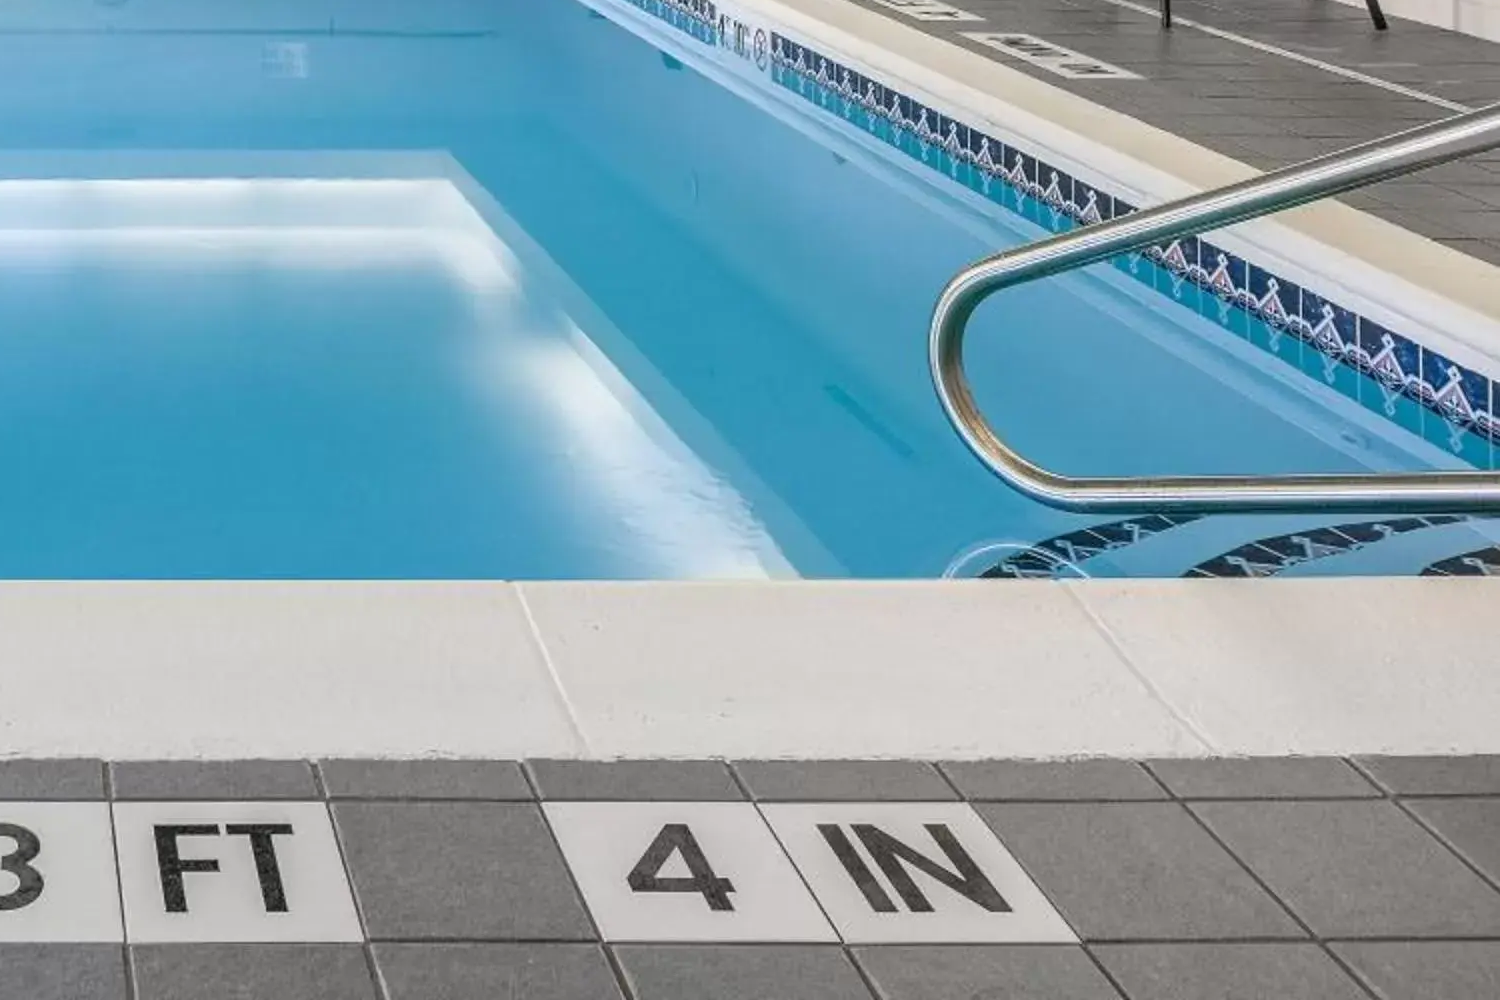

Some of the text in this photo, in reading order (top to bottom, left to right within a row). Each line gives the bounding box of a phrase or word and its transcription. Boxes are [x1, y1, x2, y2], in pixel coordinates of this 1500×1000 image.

[153, 823, 294, 913] FT
[627, 823, 736, 912] 4
[817, 823, 1013, 913] IN
